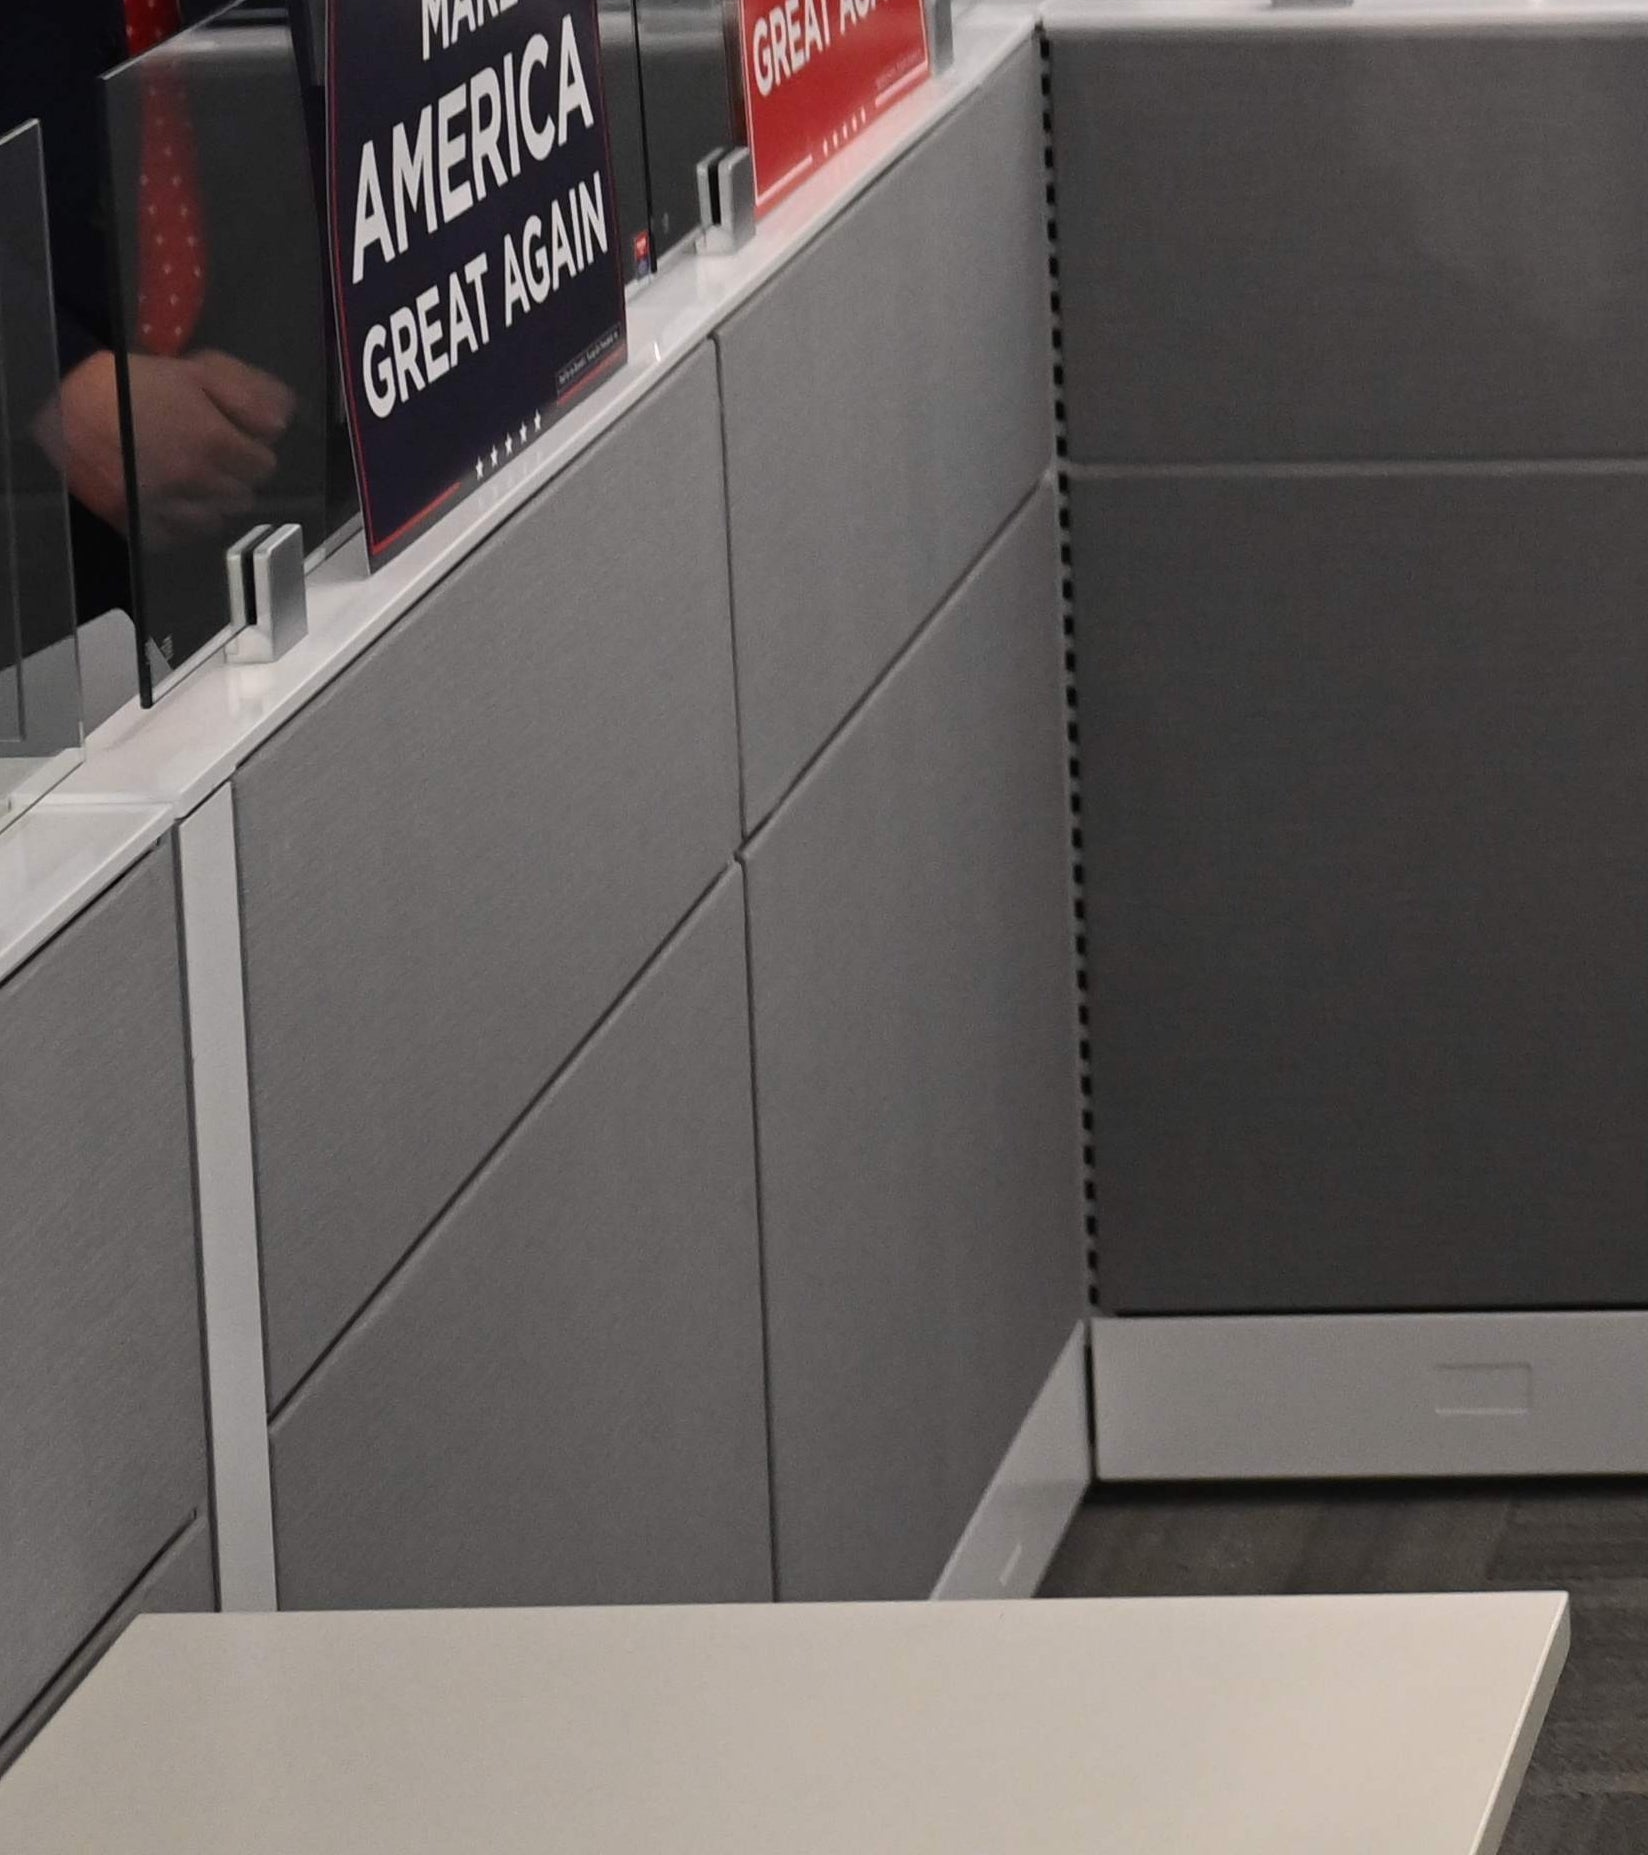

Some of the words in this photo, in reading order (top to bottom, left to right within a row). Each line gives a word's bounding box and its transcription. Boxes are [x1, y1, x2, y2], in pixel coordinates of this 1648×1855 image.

[351, 13, 594, 284] AMERICA
[361, 252, 490, 419] GREAT
[503, 170, 609, 329] AGAIN
